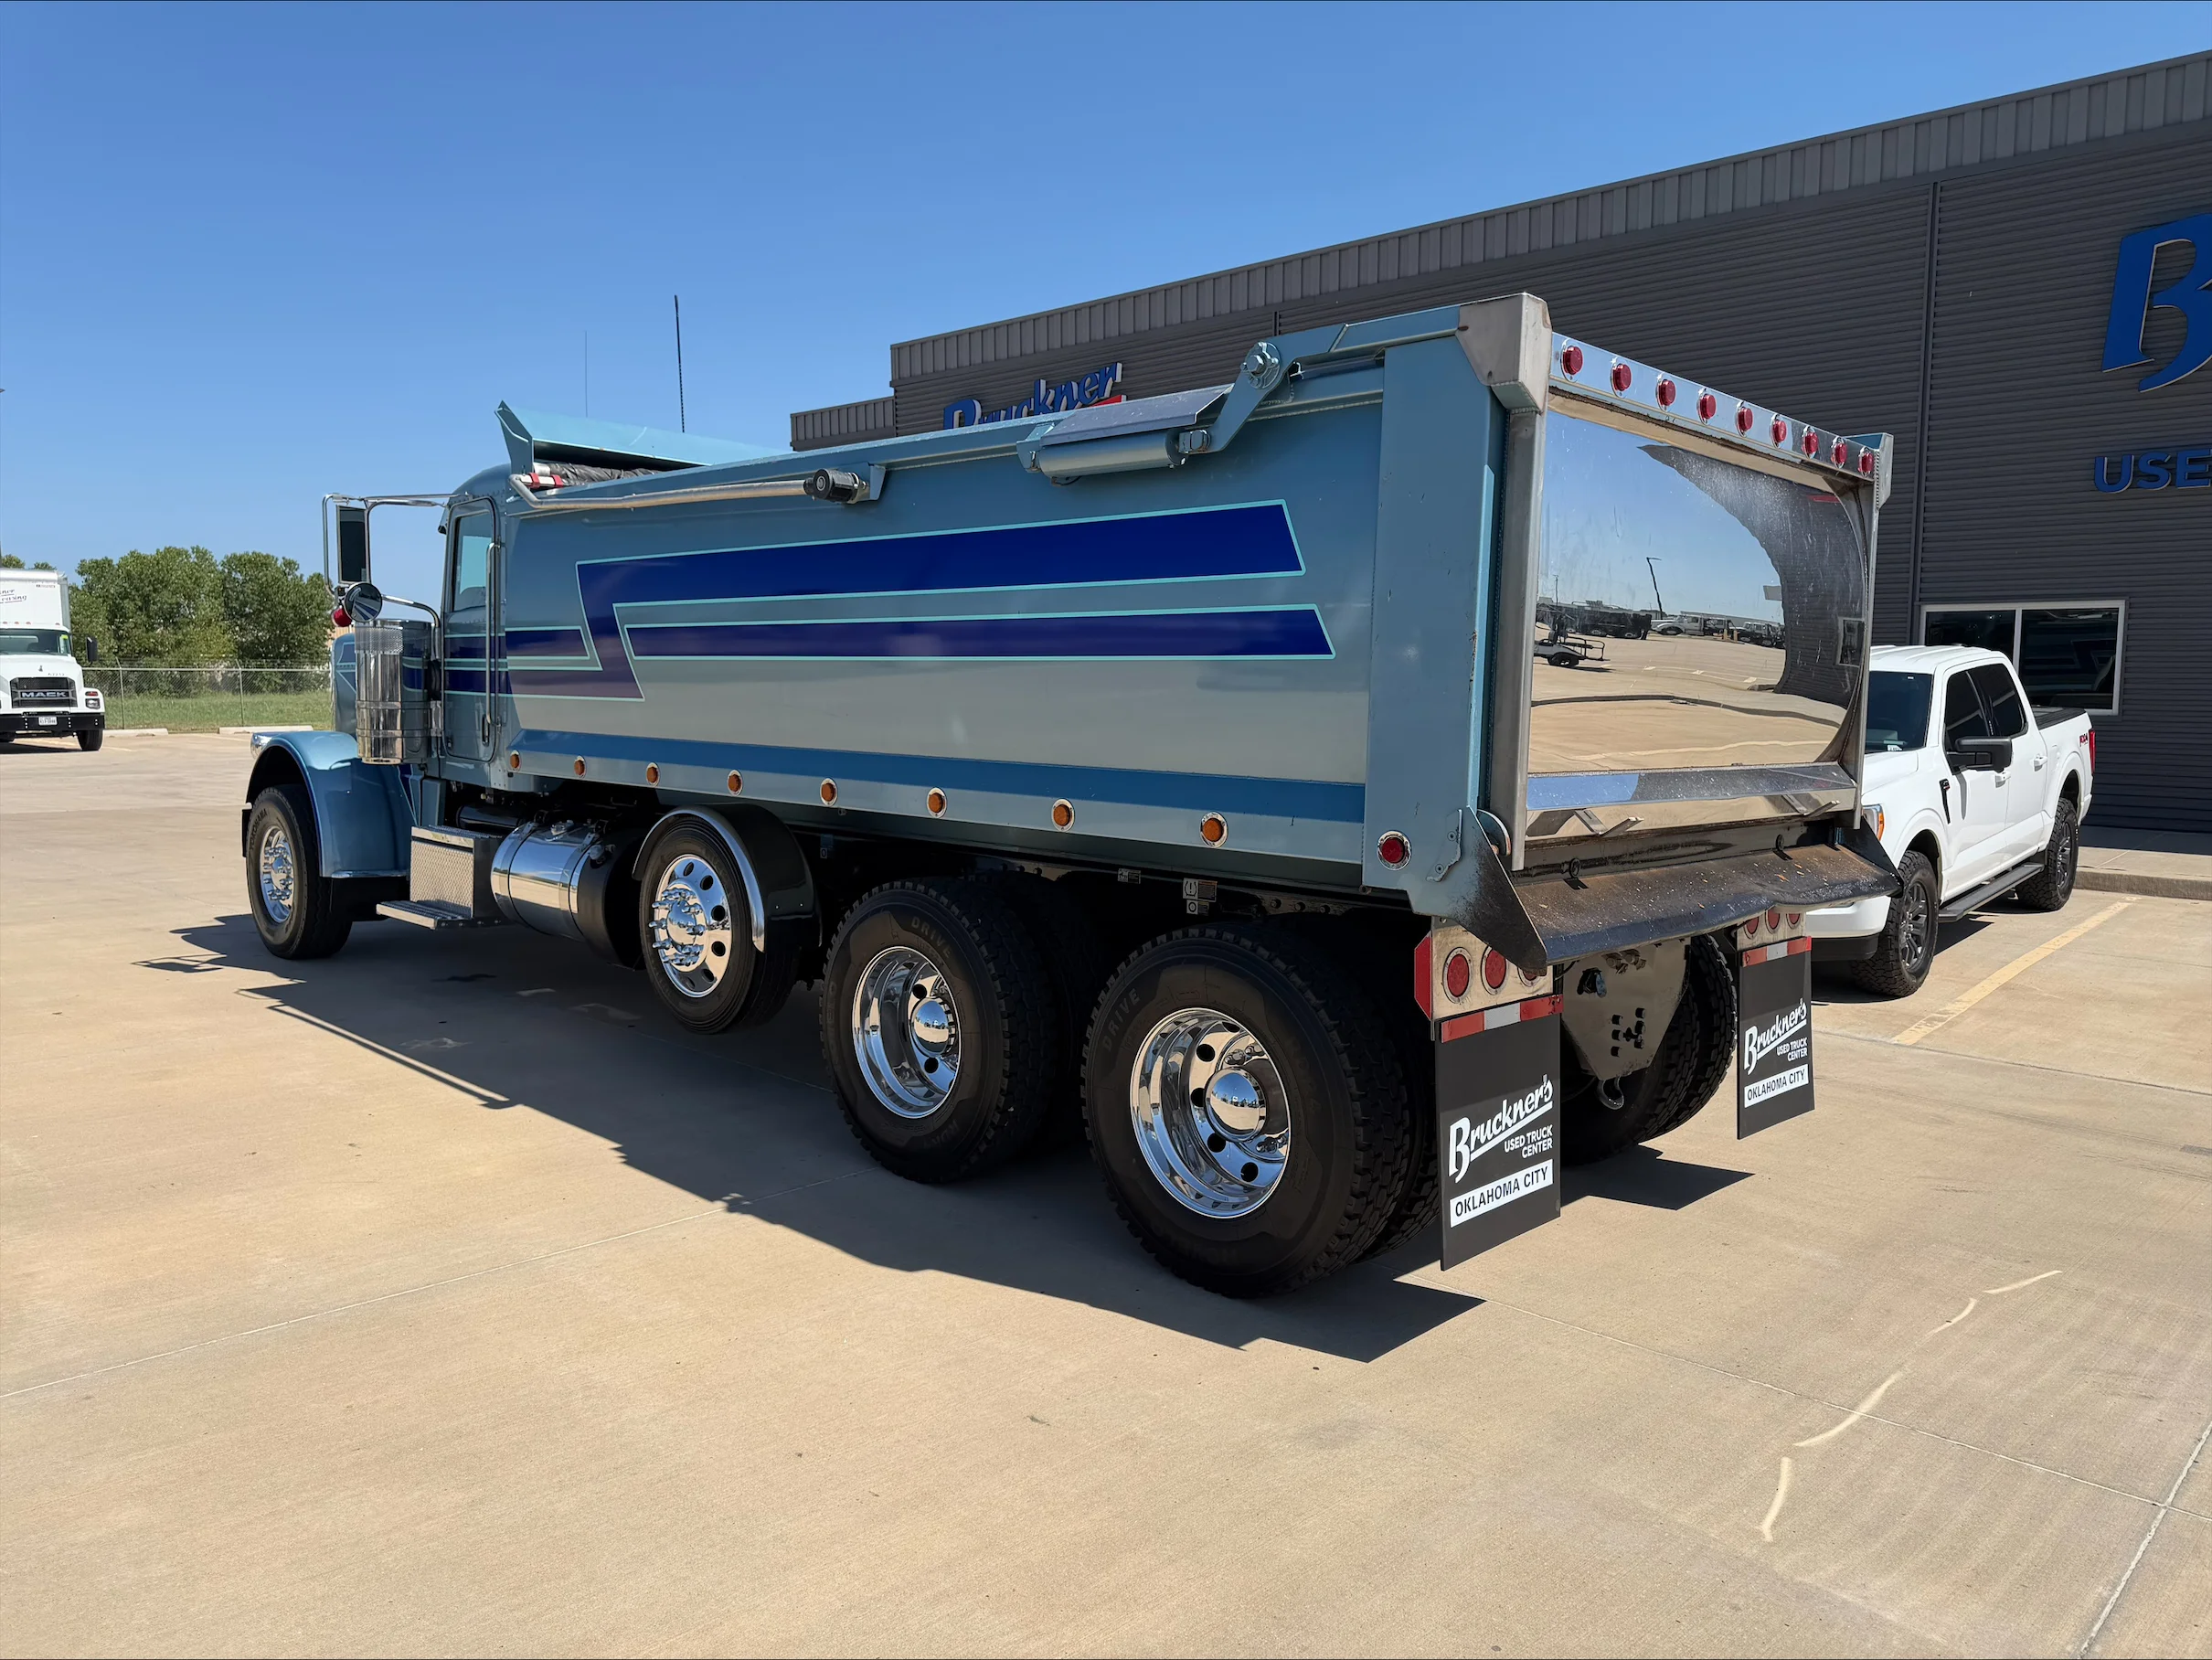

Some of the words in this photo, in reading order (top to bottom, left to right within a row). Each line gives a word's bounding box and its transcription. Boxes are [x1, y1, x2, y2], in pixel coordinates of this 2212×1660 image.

[21, 690, 67, 698] MACK
[911, 916, 952, 958] DRIVE
[1102, 987, 1141, 1052] DRIVE
[1744, 997, 1807, 1076] Bruckner's
[1776, 1044, 1790, 1056] USED
[1790, 1037, 1808, 1050] TRUCK
[1787, 1048, 1808, 1062] CENTER
[1747, 1075, 1788, 1101] OKLAHOMA
[1789, 1068, 1805, 1085] CITY
[1448, 1073, 1553, 1184] Bruckner's
[1504, 1134, 1526, 1153] USED
[1526, 1124, 1553, 1143] TRUCK
[1522, 1139, 1553, 1159] CENTER
[1454, 1181, 1520, 1218] OKLAHOMA
[1524, 1165, 1548, 1188] CITY
